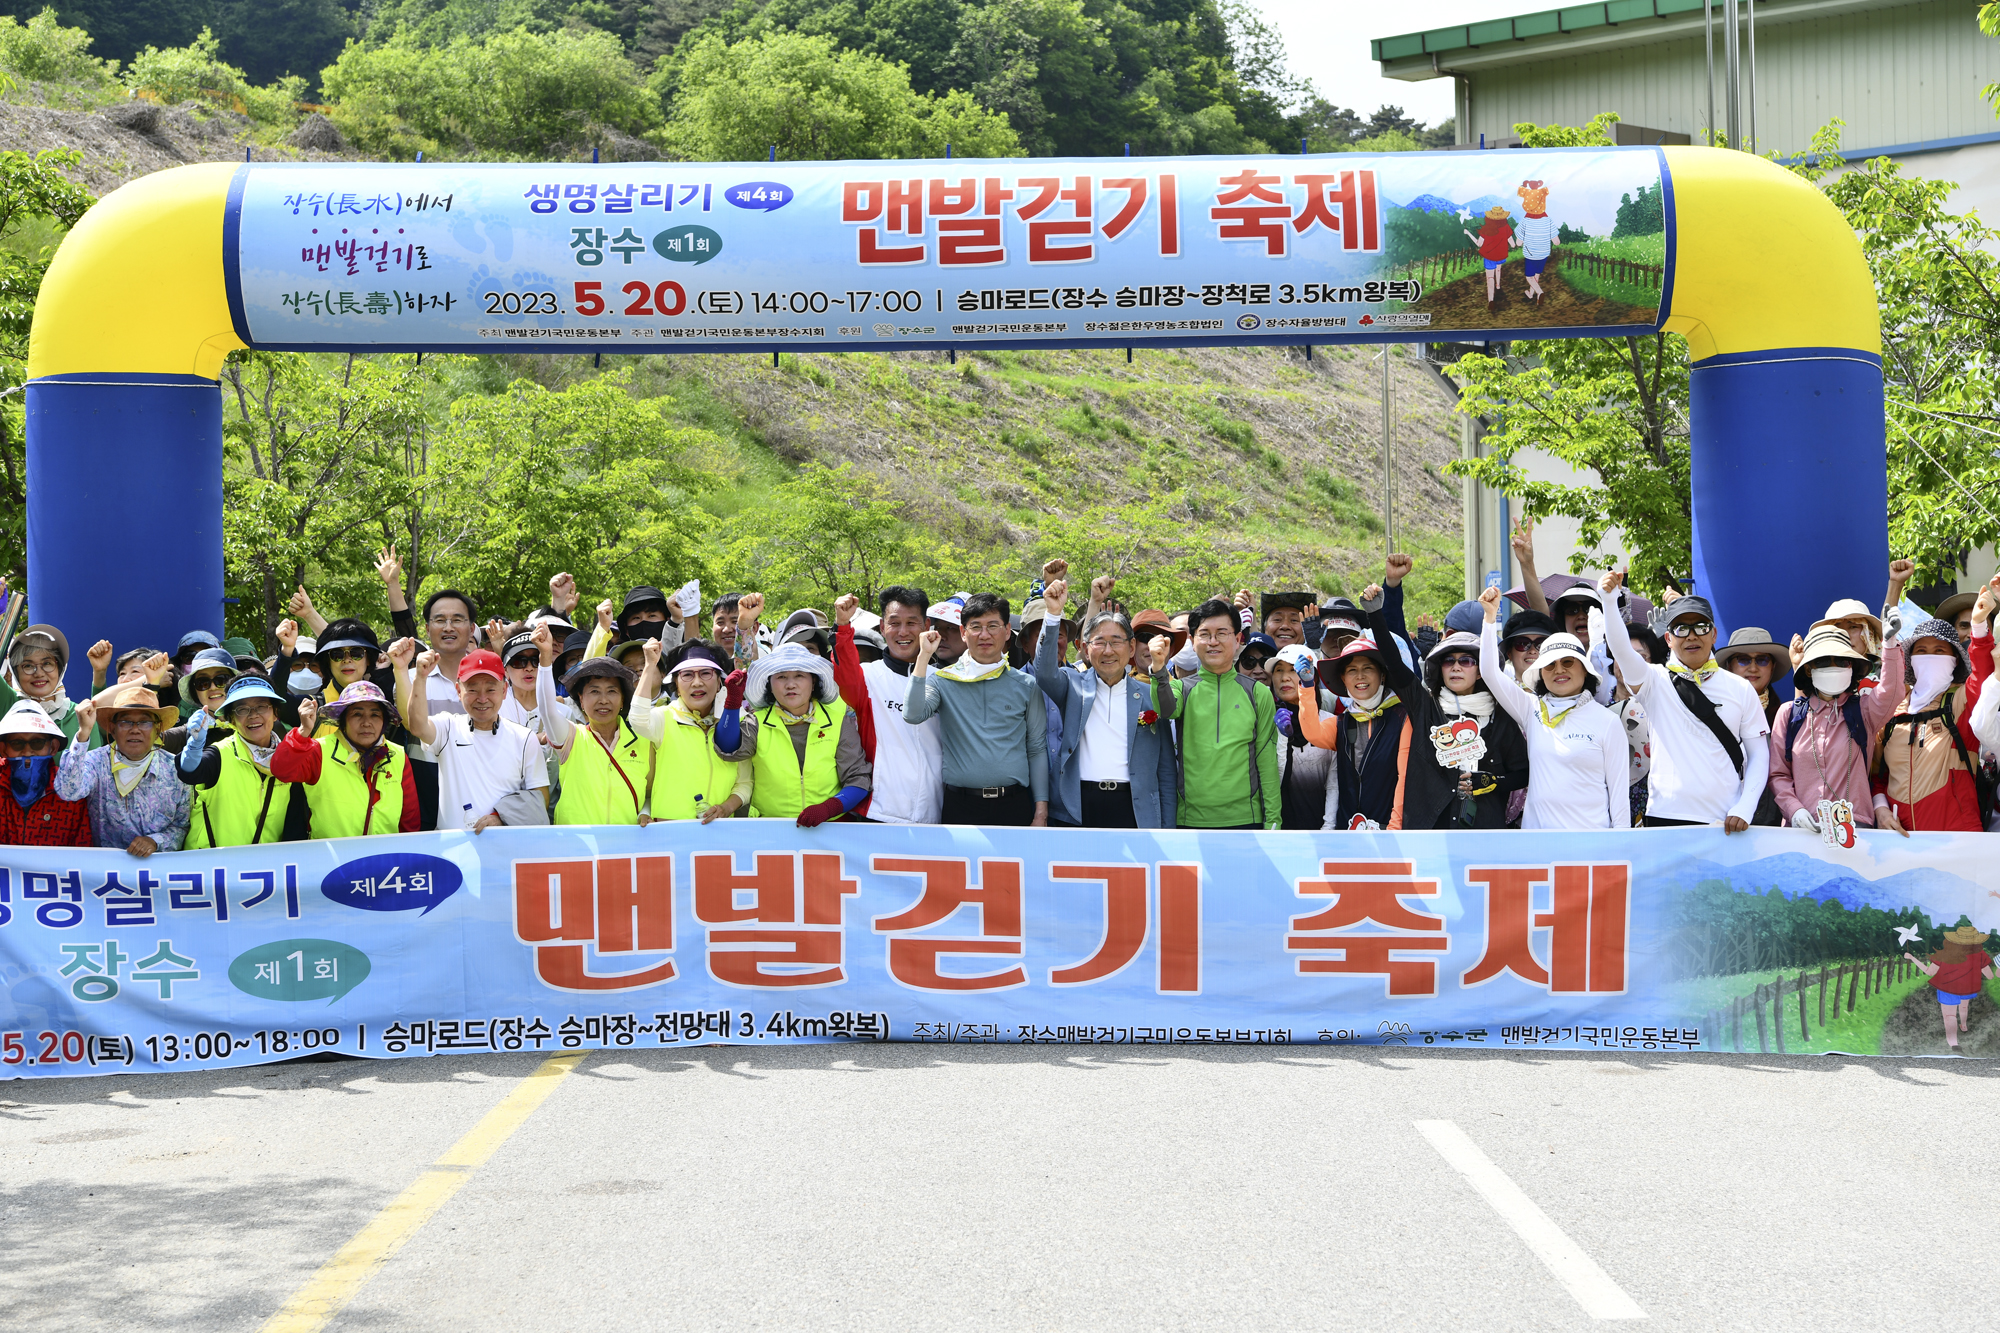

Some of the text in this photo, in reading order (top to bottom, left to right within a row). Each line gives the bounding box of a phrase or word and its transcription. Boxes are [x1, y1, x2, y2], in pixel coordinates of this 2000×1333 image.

[284, 192, 454, 217] 장수(長水)에서
[524, 181, 713, 216] 생명살리기
[735, 187, 784, 205] 제4회
[842, 170, 1382, 266] 맨발걷기 축제
[301, 238, 432, 276] 맨발걷기로
[570, 227, 646, 266] 장수
[667, 232, 710, 254] 제1회
[281, 290, 457, 316] 장수(長壽)하자
[484, 291, 566, 315] 2023.
[574, 281, 615, 316] 5.
[751, 290, 922, 314] 14:00~17:00
[957, 288, 1108, 312] 승마로드(장수
[1115, 284, 1271, 307] 승마장~장척로
[1278, 280, 1421, 304] 3.5km왕복)
[478, 313, 1430, 338] 주최 맨발걷기국민운동본부 주관 맨발걷기국민운동본부장수지회 후원 장수군 맨발걷기국민운동본부 장수젊은한우영농조합법인 장수자율방범대 사랑의열매
[0, 864, 302, 928] 명살리기
[350, 866, 435, 898] 제4회
[513, 853, 1631, 997] 맨발걷기 축제
[58, 940, 200, 1001] 장수
[253, 950, 339, 985] 제1회
[3, 1031, 134, 1065] 5.20(토)
[145, 1029, 340, 1063] 13:00~18:00
[383, 1017, 552, 1052] 승마로드(장수
[558, 1010, 730, 1047] 승마장~전망대
[739, 1011, 890, 1040] 3.4km왕복)
[913, 1022, 1000, 1042] 주최/주관
[1500, 1026, 1700, 1051] 맨발걷기국민운동본부
